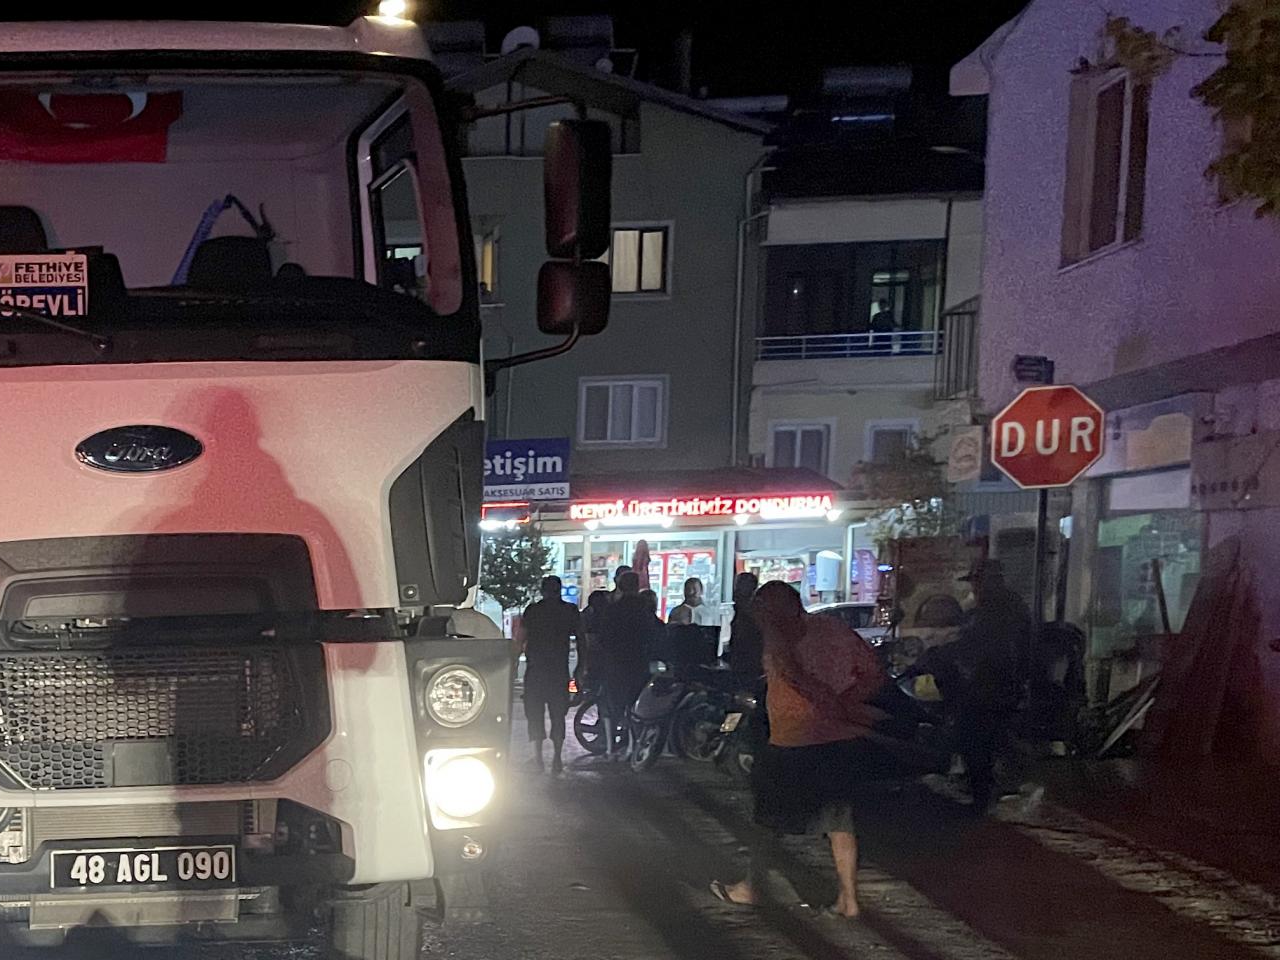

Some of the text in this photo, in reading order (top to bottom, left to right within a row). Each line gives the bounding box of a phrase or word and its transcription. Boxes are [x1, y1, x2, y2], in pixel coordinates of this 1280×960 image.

[1001, 417, 1095, 457] DUR
[539, 486, 566, 496] SATIŞ
[570, 496, 832, 519] KENDİ ÜRETİMİMİZ DONDURMA
[70, 851, 229, 884] 48 AGL 090
